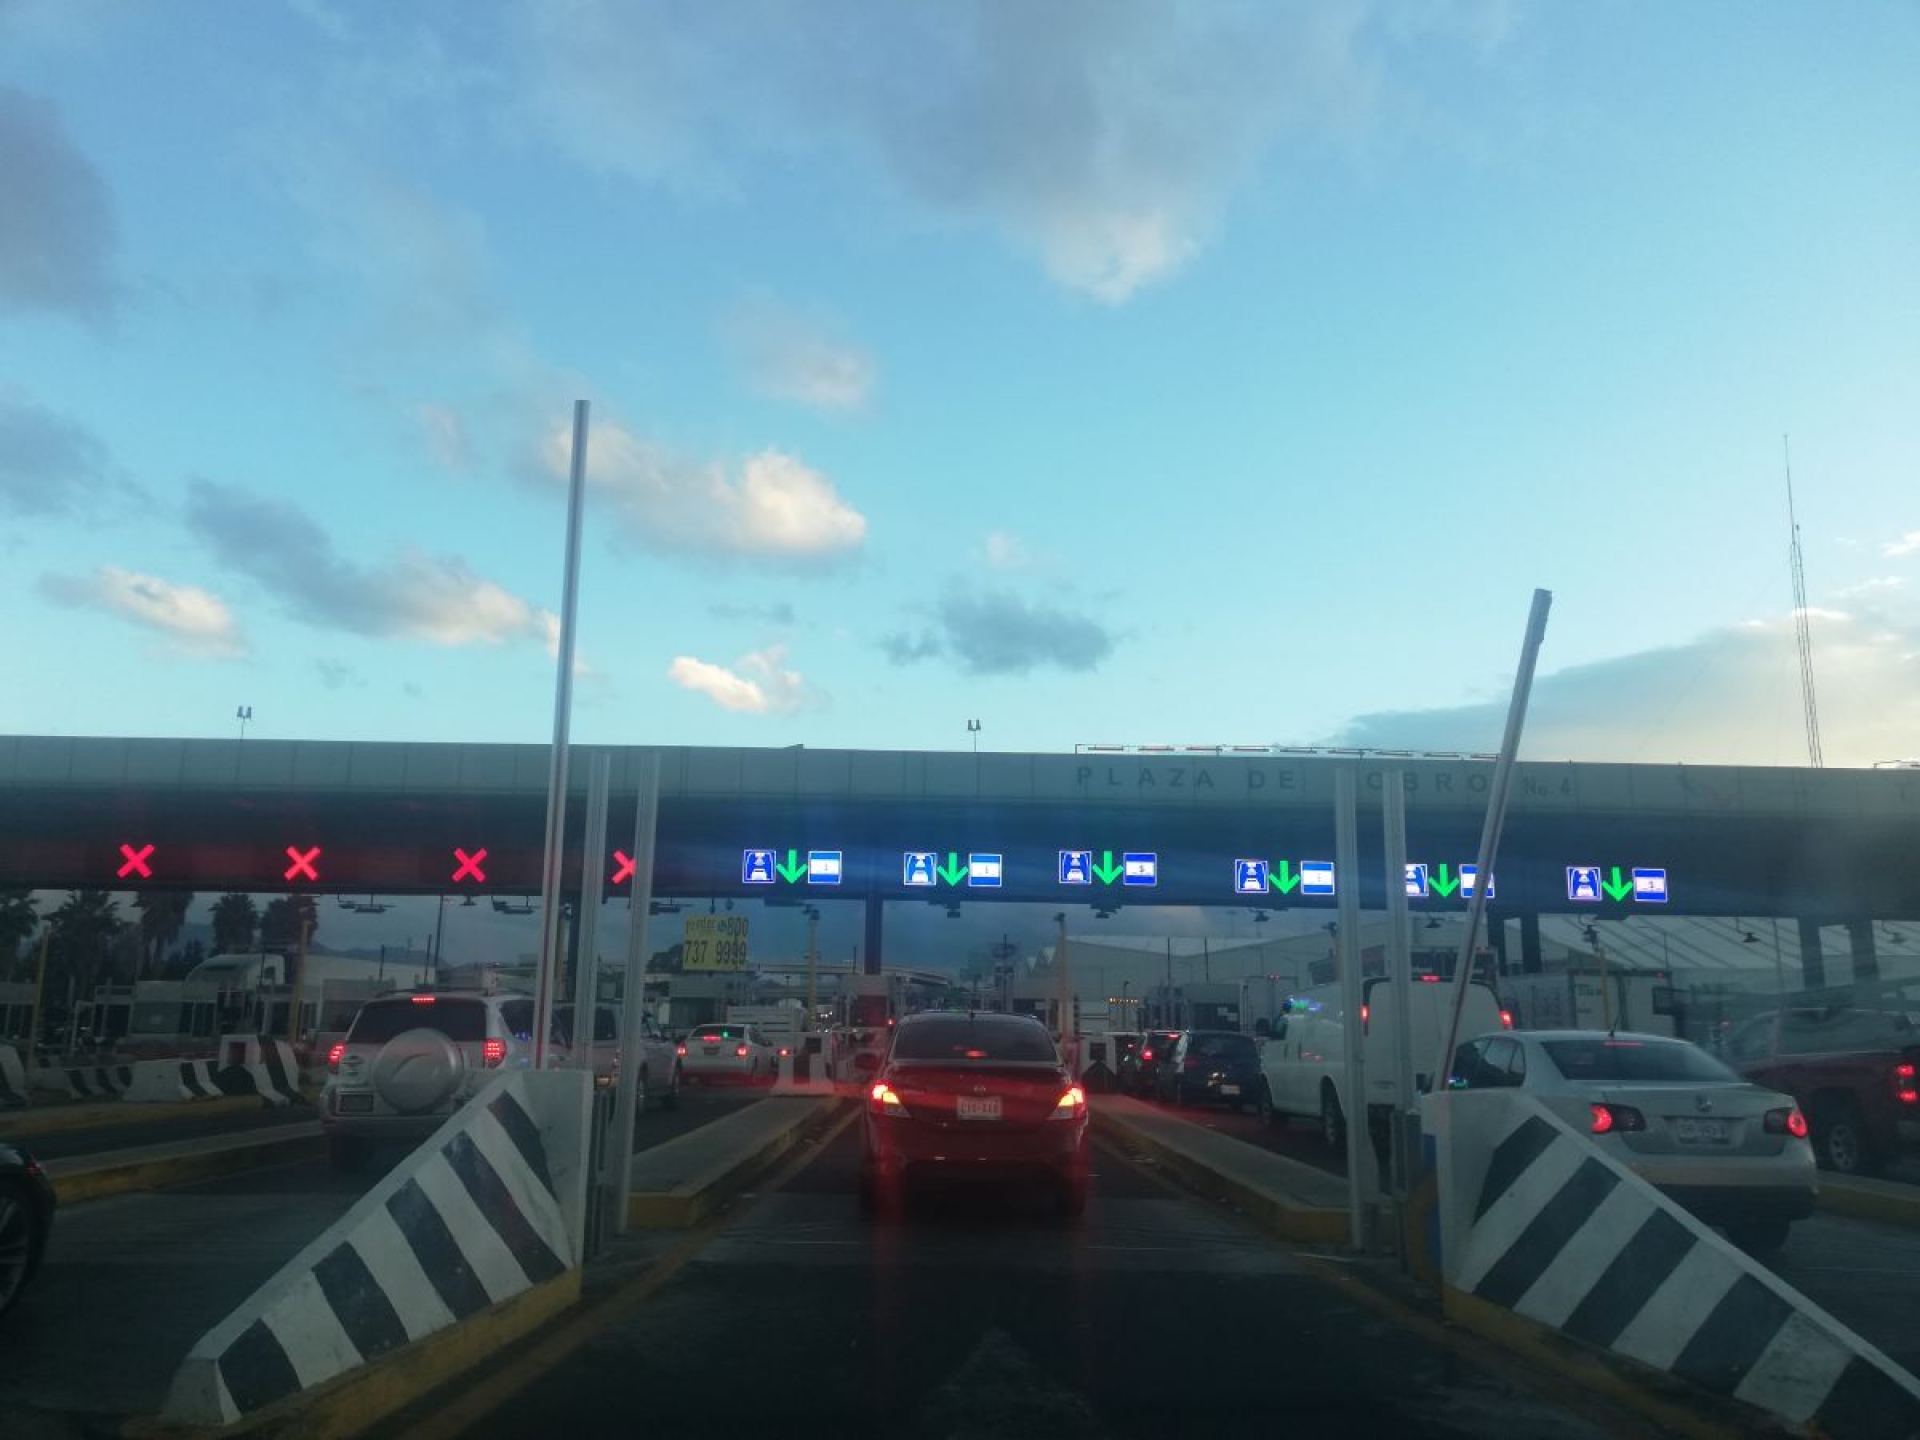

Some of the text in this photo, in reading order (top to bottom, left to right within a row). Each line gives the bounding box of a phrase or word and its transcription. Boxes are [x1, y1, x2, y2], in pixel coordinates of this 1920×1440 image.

[1077, 768, 1215, 788] PLAZA
[1249, 770, 1297, 790] DE
[1366, 771, 1487, 793] OBRO
[1560, 776, 1571, 795] 4
[685, 940, 708, 963] 737
